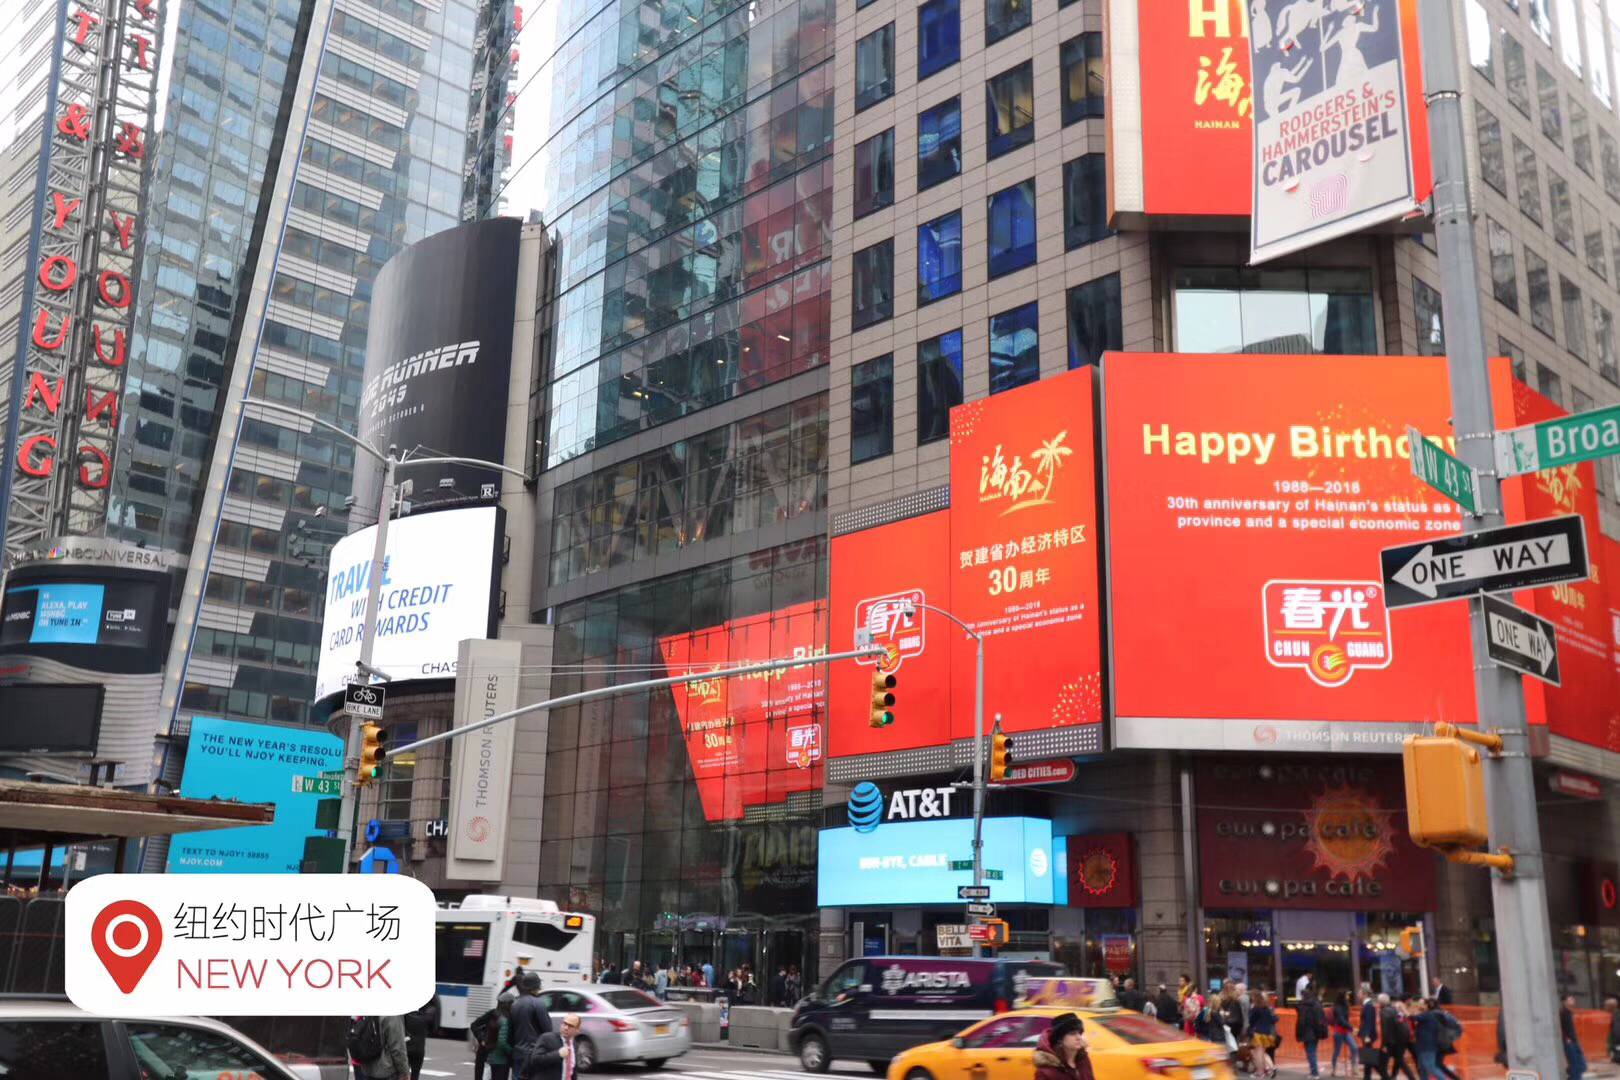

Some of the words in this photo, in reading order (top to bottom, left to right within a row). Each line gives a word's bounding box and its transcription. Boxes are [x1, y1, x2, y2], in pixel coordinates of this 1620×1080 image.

[1188, 0, 1249, 37] H
[1194, 46, 1253, 120] 海
[1194, 120, 1240, 129] HAINAN
[1262, 90, 1396, 163] HAMMERSTEIN'S
[1280, 89, 1357, 138] RODGERS
[1362, 82, 1374, 100] &
[1262, 111, 1398, 187] CAROUSEL
[17, 192, 80, 477] YOUNG
[380, 340, 480, 393] RUNNER
[1142, 423, 1276, 465] Happy
[1289, 425, 1456, 460] Birth
[979, 444, 1032, 501] 海南
[1424, 444, 1439, 484] W
[1444, 462, 1460, 498] 43
[1167, 496, 1199, 509] 30th
[1203, 497, 1290, 512] anniversary
[1296, 498, 1310, 511] of
[1315, 499, 1379, 512] Hainan's
[1384, 500, 1428, 513] status
[1434, 503, 1451, 513] as
[1177, 515, 1241, 529] province
[1246, 515, 1273, 528] and
[1278, 518, 1287, 528] a
[1292, 517, 1345, 530] special
[1349, 518, 1420, 530] economic
[1425, 520, 1461, 531] zone
[64, 548, 168, 568] NBCUNIVERSAL
[960, 524, 1086, 569] 贺建省办经济特区
[1411, 554, 1466, 585] ONE
[1493, 539, 1555, 571] WAY
[988, 565, 1051, 596] 30周年
[351, 592, 384, 619] WIH
[388, 583, 453, 610] CREDIT
[1280, 587, 1370, 642] 春光
[330, 625, 354, 651] CARD
[355, 611, 431, 641] RWARDS
[1273, 640, 1310, 656] CHUN
[1346, 641, 1385, 658] GUANG
[1497, 619, 1520, 649] ONE
[1528, 632, 1548, 662] WAY
[347, 703, 362, 713] BIKE
[363, 705, 380, 716] LANE
[482, 673, 498, 736] RUTERS
[203, 733, 225, 743] THE
[229, 736, 253, 747] NEW
[257, 739, 297, 753] YEAR'S
[301, 744, 342, 758] RESOLU
[1286, 731, 1350, 742] THOMSON
[201, 744, 241, 758] YOU'LL
[245, 751, 275, 762] NJOY
[278, 755, 328, 768] KEEPING.
[475, 739, 492, 808] THOMSON
[305, 779, 314, 791] W
[318, 780, 330, 793] 43
[888, 787, 956, 820] AT&T
[1219, 879, 1316, 898] europa
[1325, 878, 1383, 898] cafe
[939, 936, 962, 947] VITA
